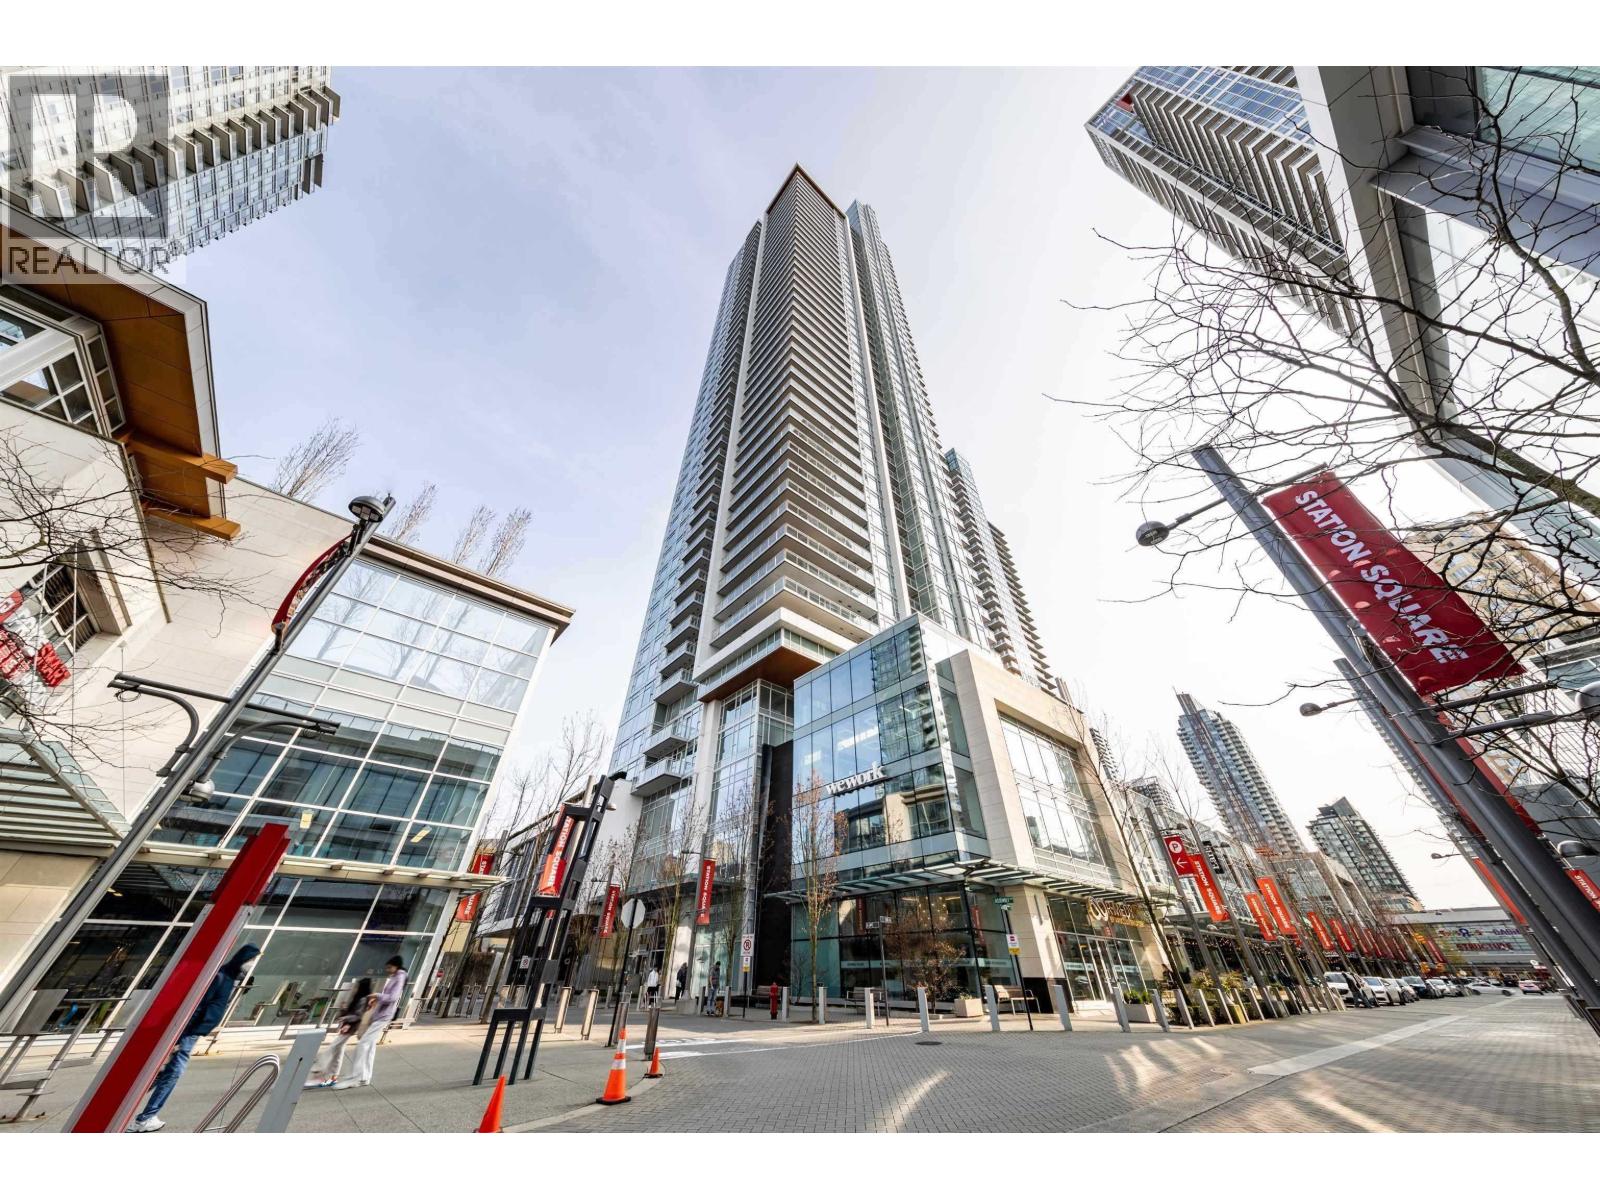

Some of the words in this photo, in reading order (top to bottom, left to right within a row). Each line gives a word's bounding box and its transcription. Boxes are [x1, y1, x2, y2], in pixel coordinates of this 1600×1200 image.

[1295, 490, 1372, 562] STATION
[1360, 564, 1469, 664] SQUARE
[560, 815, 575, 848] TATION
[547, 850, 563, 887] SQUARE
[1574, 875, 1598, 899] STATION
[1194, 860, 1210, 886] STATION
[1206, 887, 1223, 915] SQUARE
